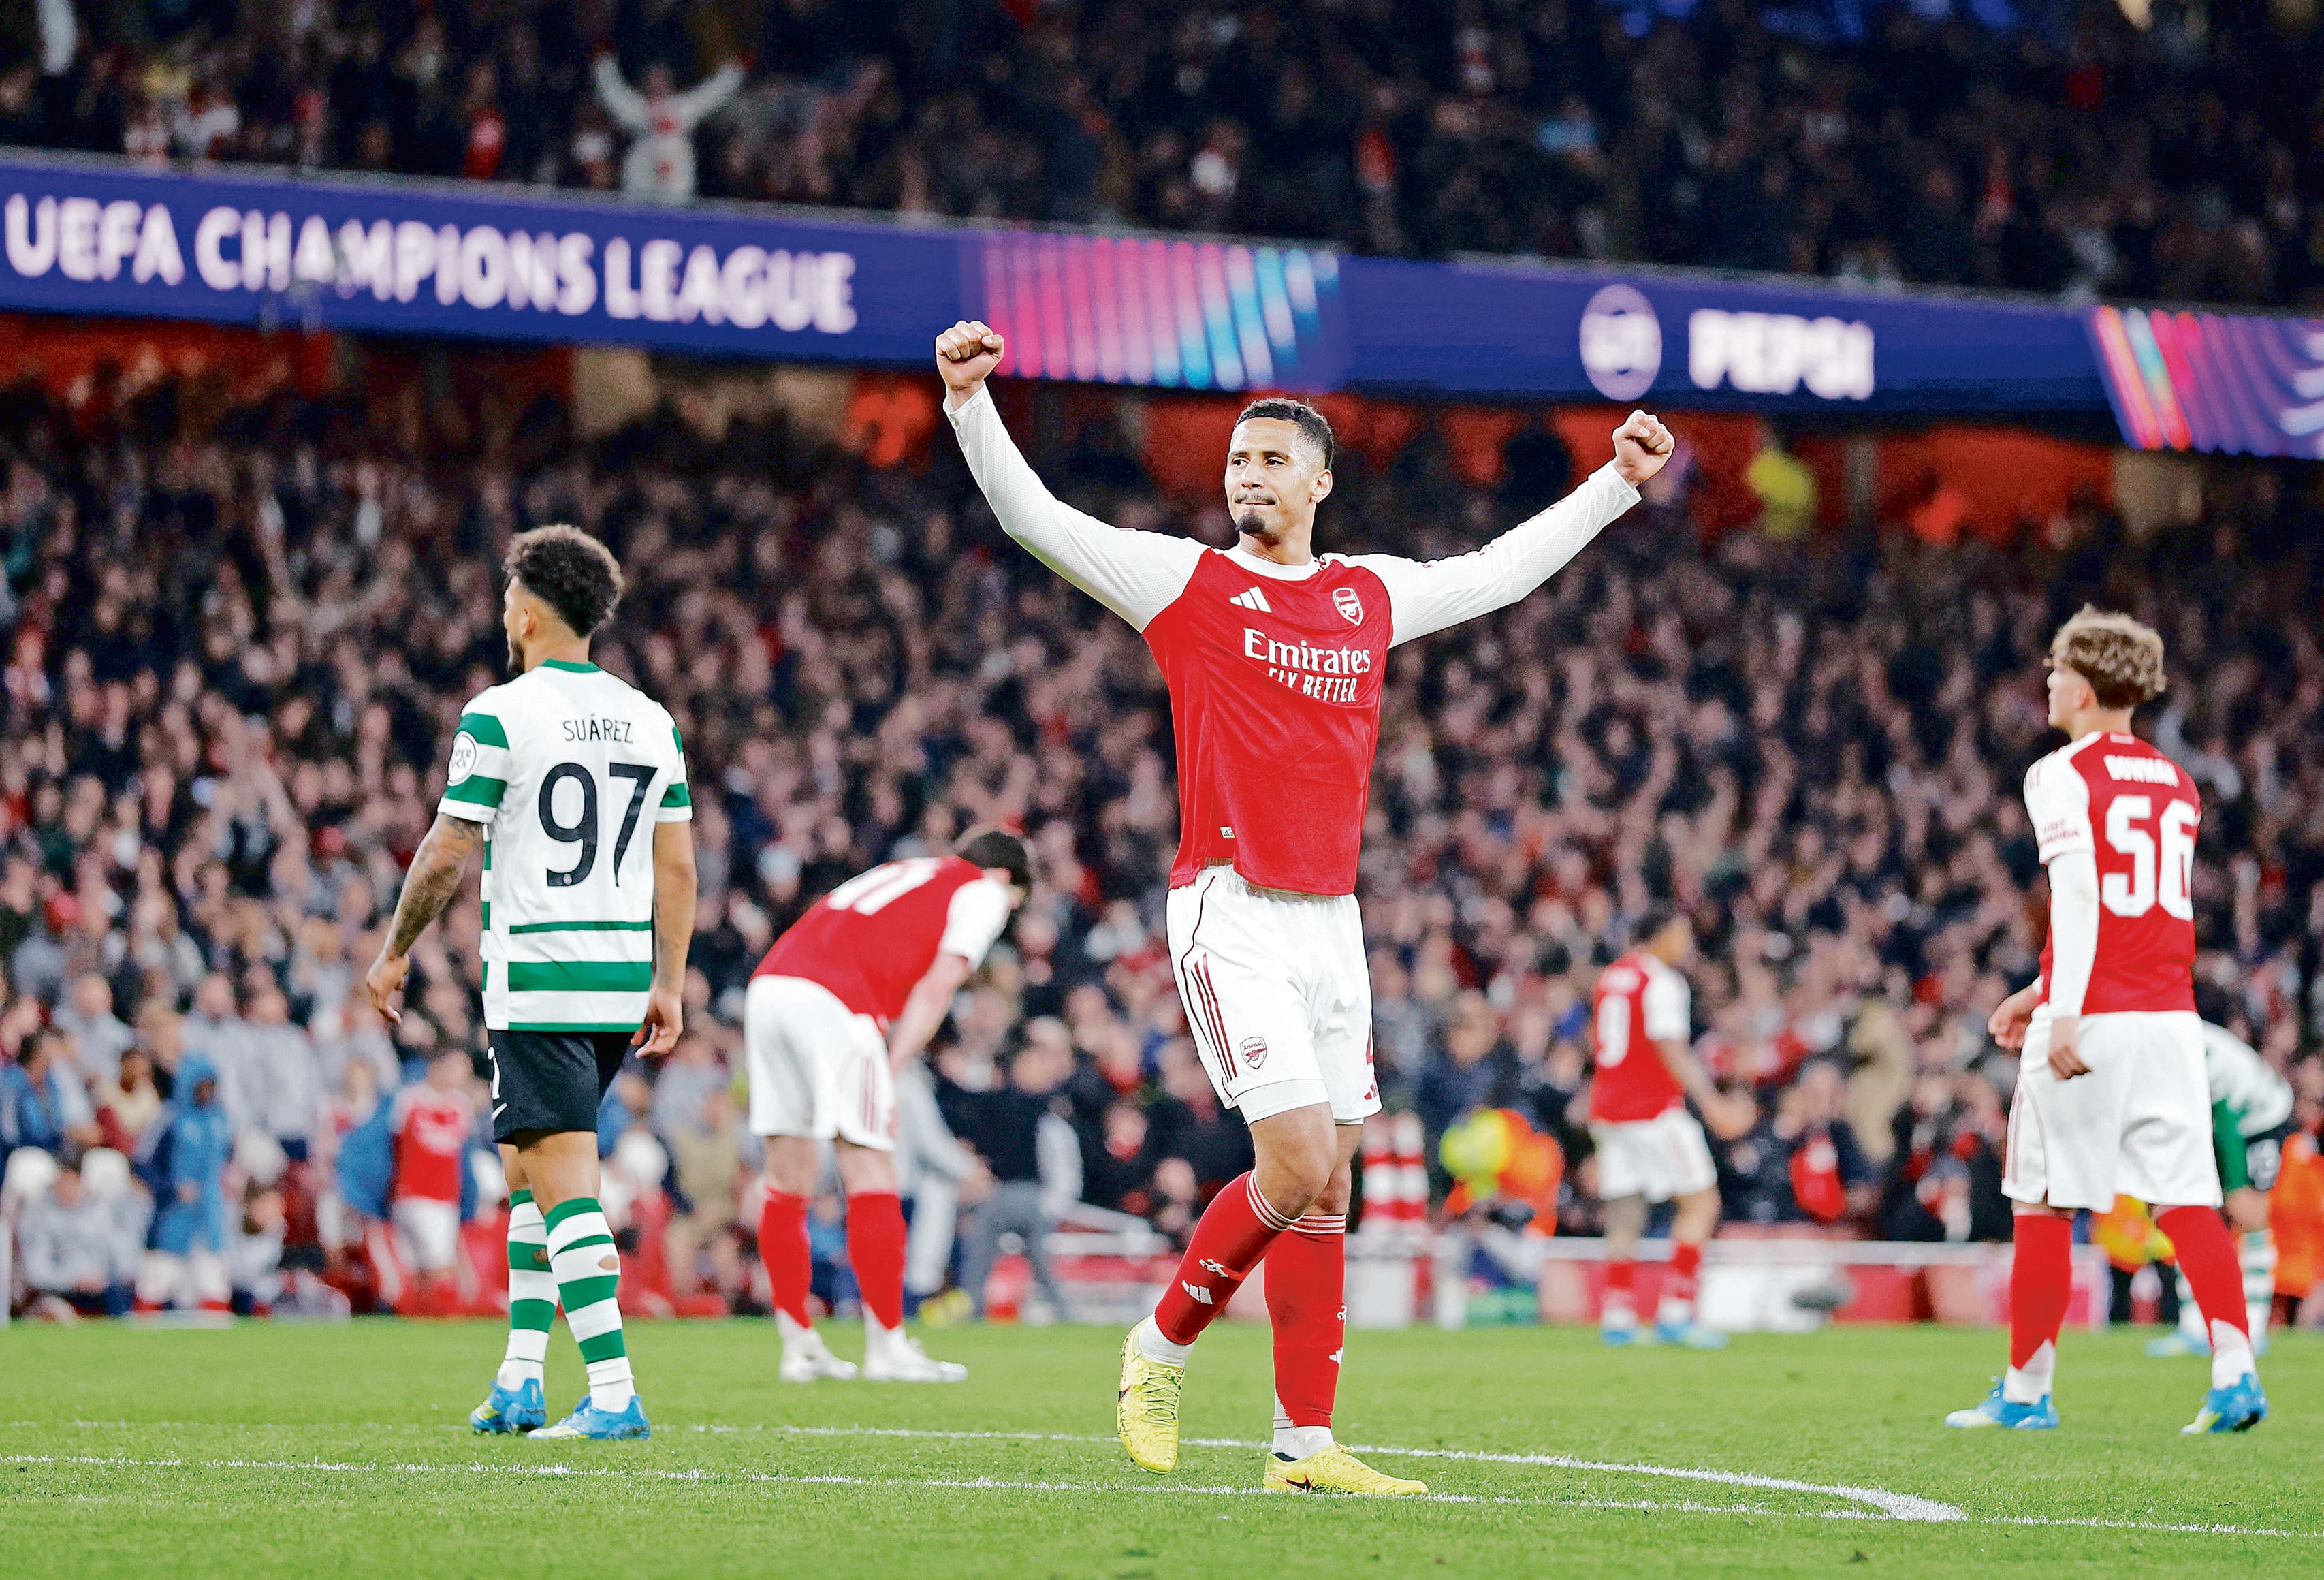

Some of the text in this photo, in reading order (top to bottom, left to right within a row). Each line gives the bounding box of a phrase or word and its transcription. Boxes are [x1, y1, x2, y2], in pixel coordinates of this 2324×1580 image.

[4, 193, 858, 334] UEFA CHAMPIONS LEAGUE
[1243, 627, 1371, 674] Emirates
[1303, 674, 1358, 703] BETTER
[562, 713, 634, 744] SUÁREZ
[539, 762, 658, 888] 97
[2101, 795, 2195, 921] 56
